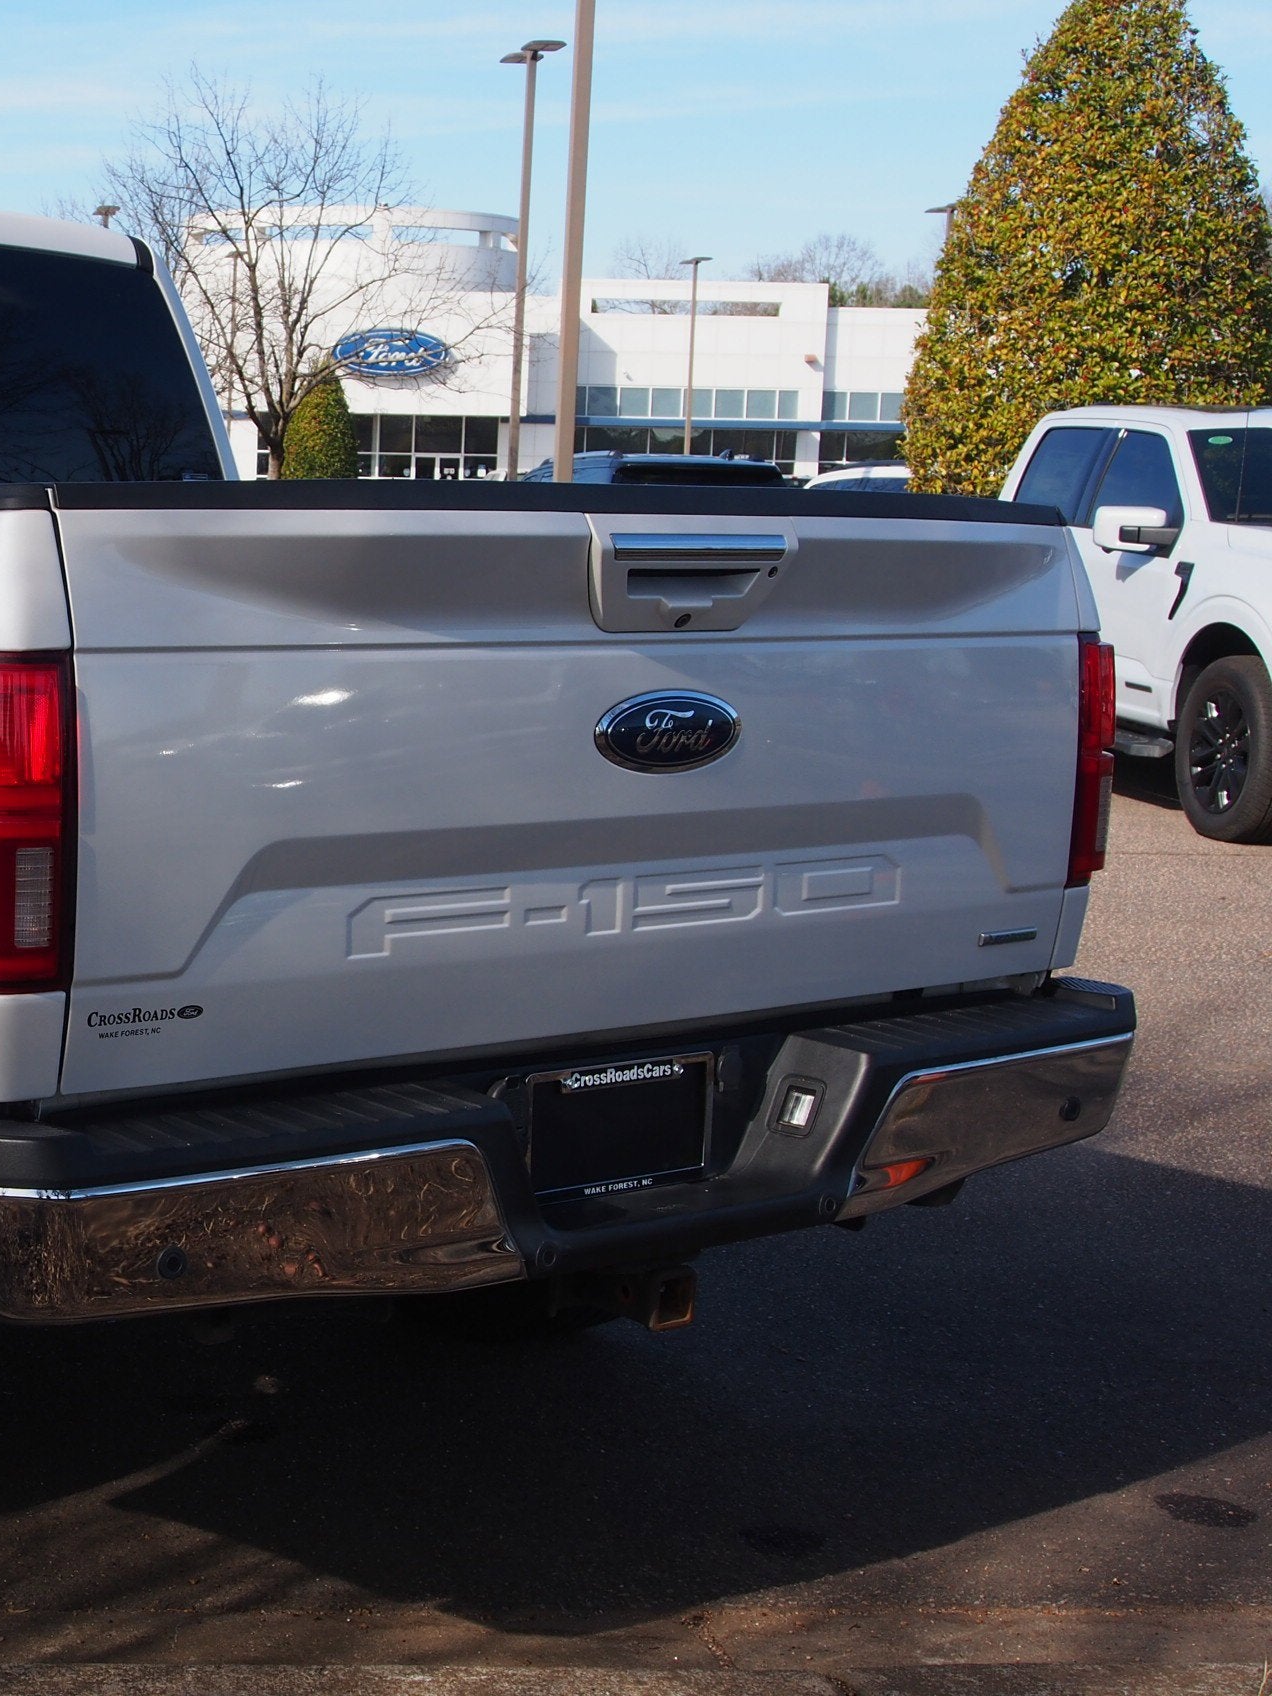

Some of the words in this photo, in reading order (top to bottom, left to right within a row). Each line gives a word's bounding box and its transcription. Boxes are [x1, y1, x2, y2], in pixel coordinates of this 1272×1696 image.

[636, 709, 713, 753] Ford
[346, 854, 901, 959] F-150
[98, 1031, 119, 1039] WAKE
[571, 1063, 671, 1089] CrossRoadsCars
[584, 1186, 606, 1195] WAKE
[609, 1181, 640, 1192] FOREST,
[642, 1178, 653, 1186] NC
